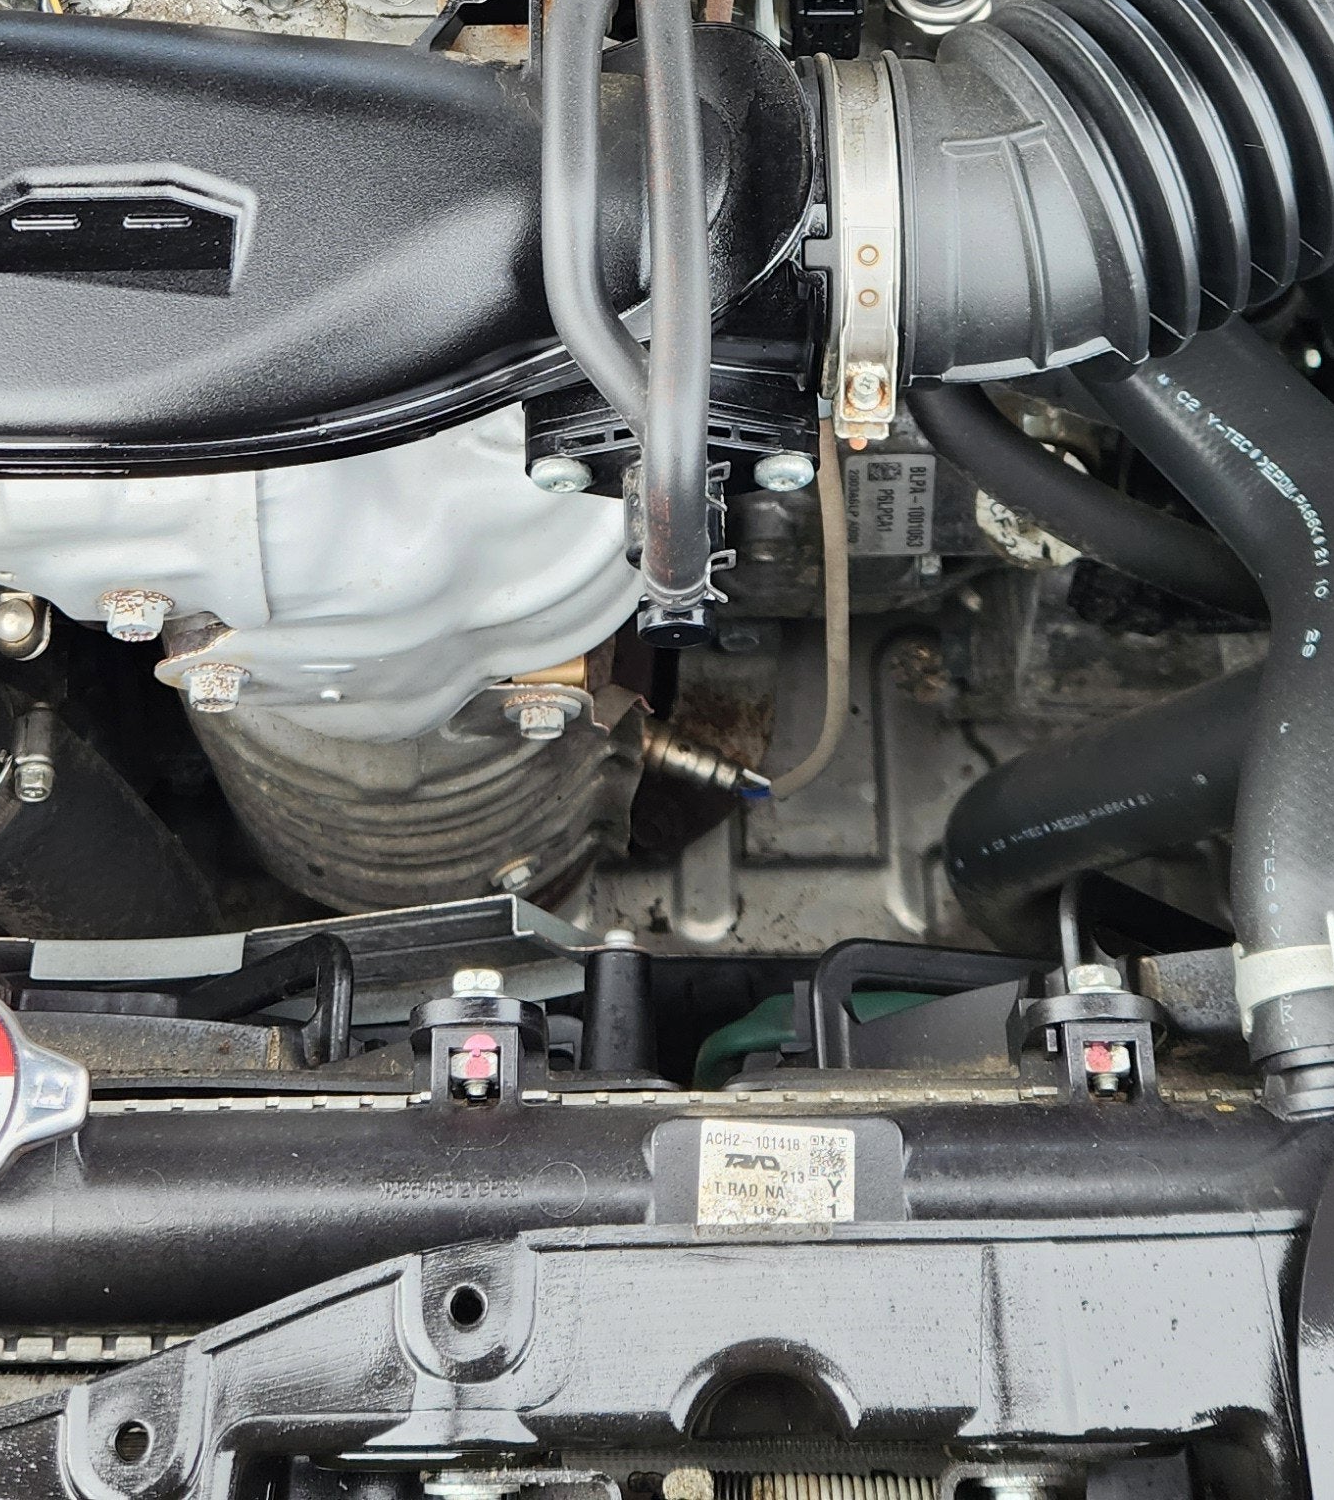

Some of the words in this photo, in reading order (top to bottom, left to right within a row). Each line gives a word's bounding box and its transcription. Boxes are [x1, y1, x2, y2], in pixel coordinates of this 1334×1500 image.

[1176, 390, 1202, 412] C2
[765, 1185, 785, 1200] NA
[827, 1178, 843, 1198] Y
[827, 1202, 837, 1219] 1
